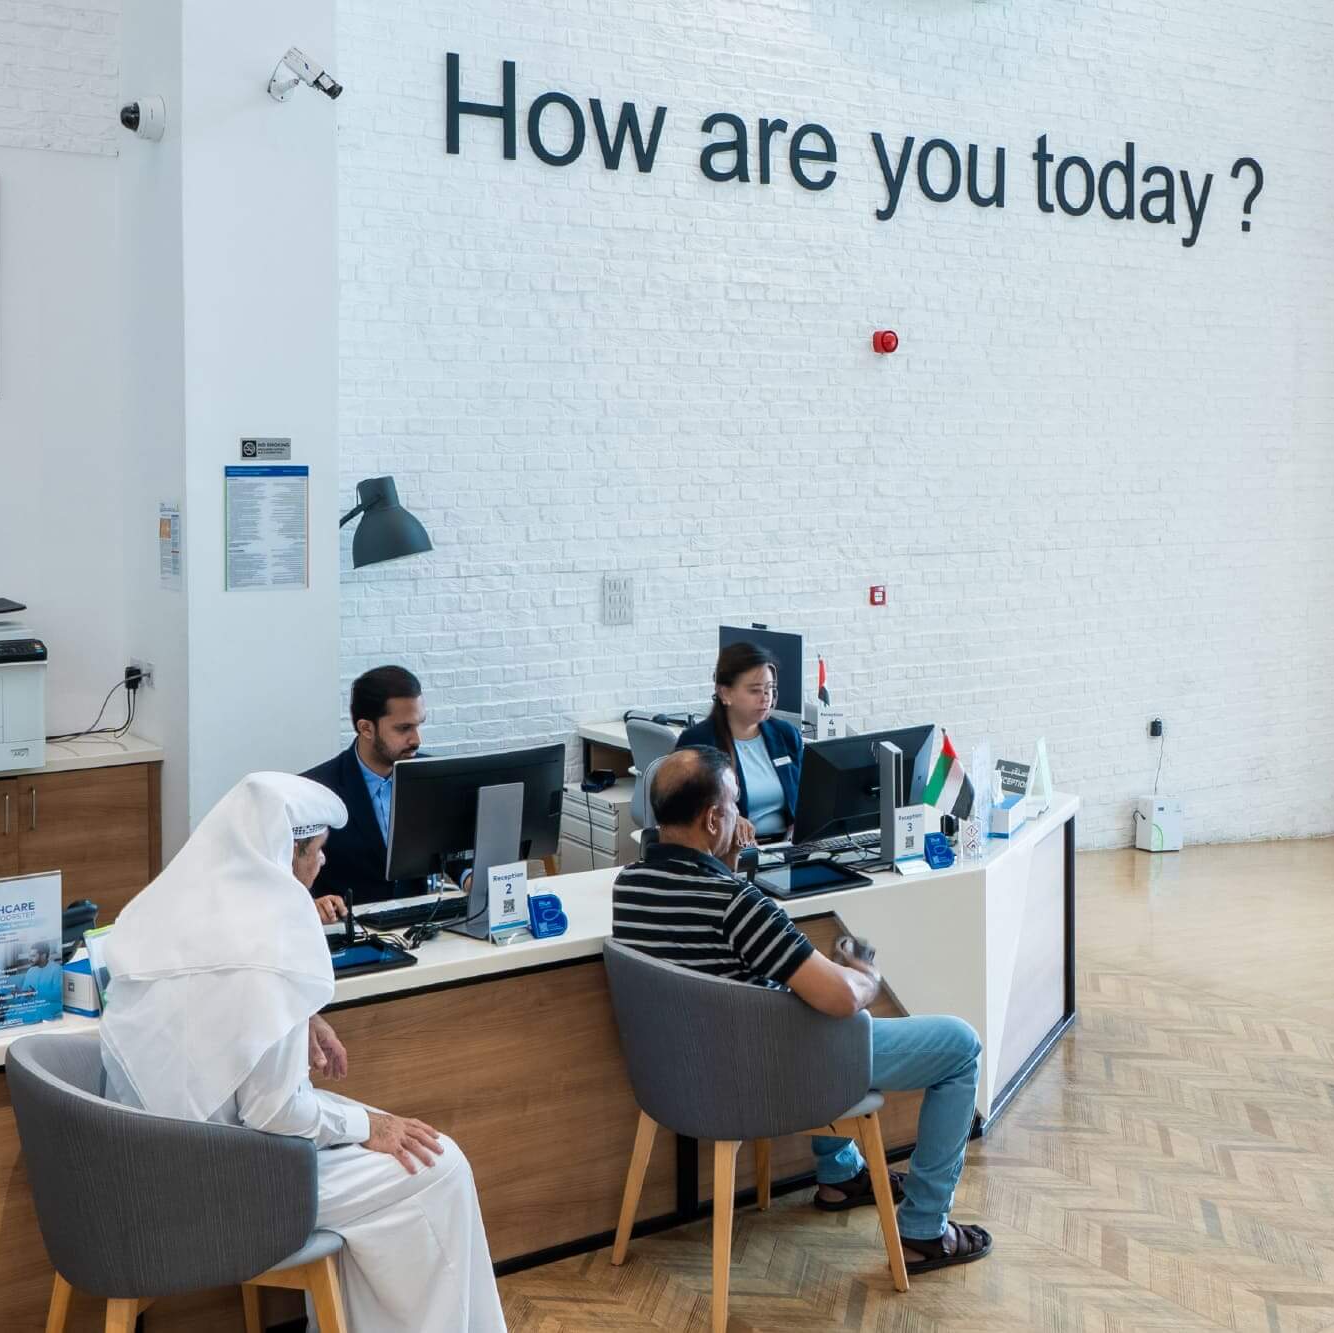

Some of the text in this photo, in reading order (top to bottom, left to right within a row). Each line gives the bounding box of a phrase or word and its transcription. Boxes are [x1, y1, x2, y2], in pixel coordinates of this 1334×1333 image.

[445, 51, 1266, 248] How are you today ?
[907, 822, 913, 832] 3
[493, 872, 524, 882] Reception
[505, 883, 513, 895] 2
